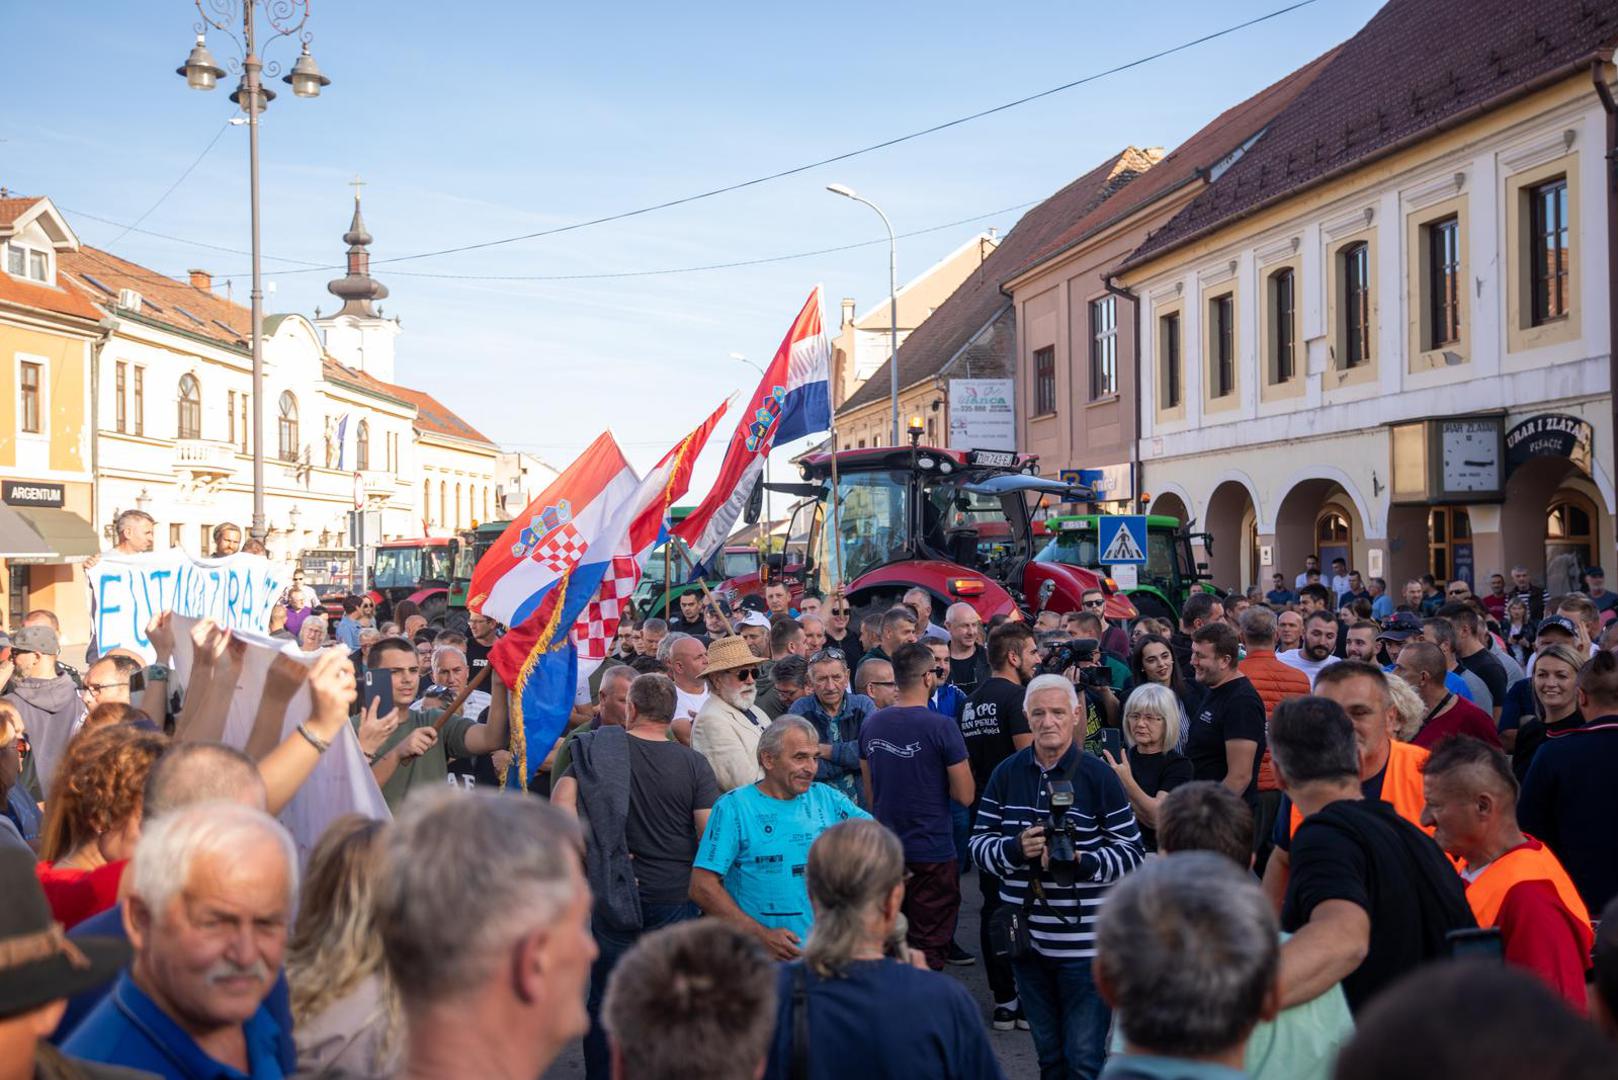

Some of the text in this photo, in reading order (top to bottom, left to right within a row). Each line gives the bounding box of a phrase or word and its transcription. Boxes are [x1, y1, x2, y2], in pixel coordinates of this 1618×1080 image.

[1506, 421, 1536, 449] URAR
[1537, 419, 1543, 432] I
[11, 486, 61, 501] ARGENTUM
[976, 702, 997, 717] OPG
